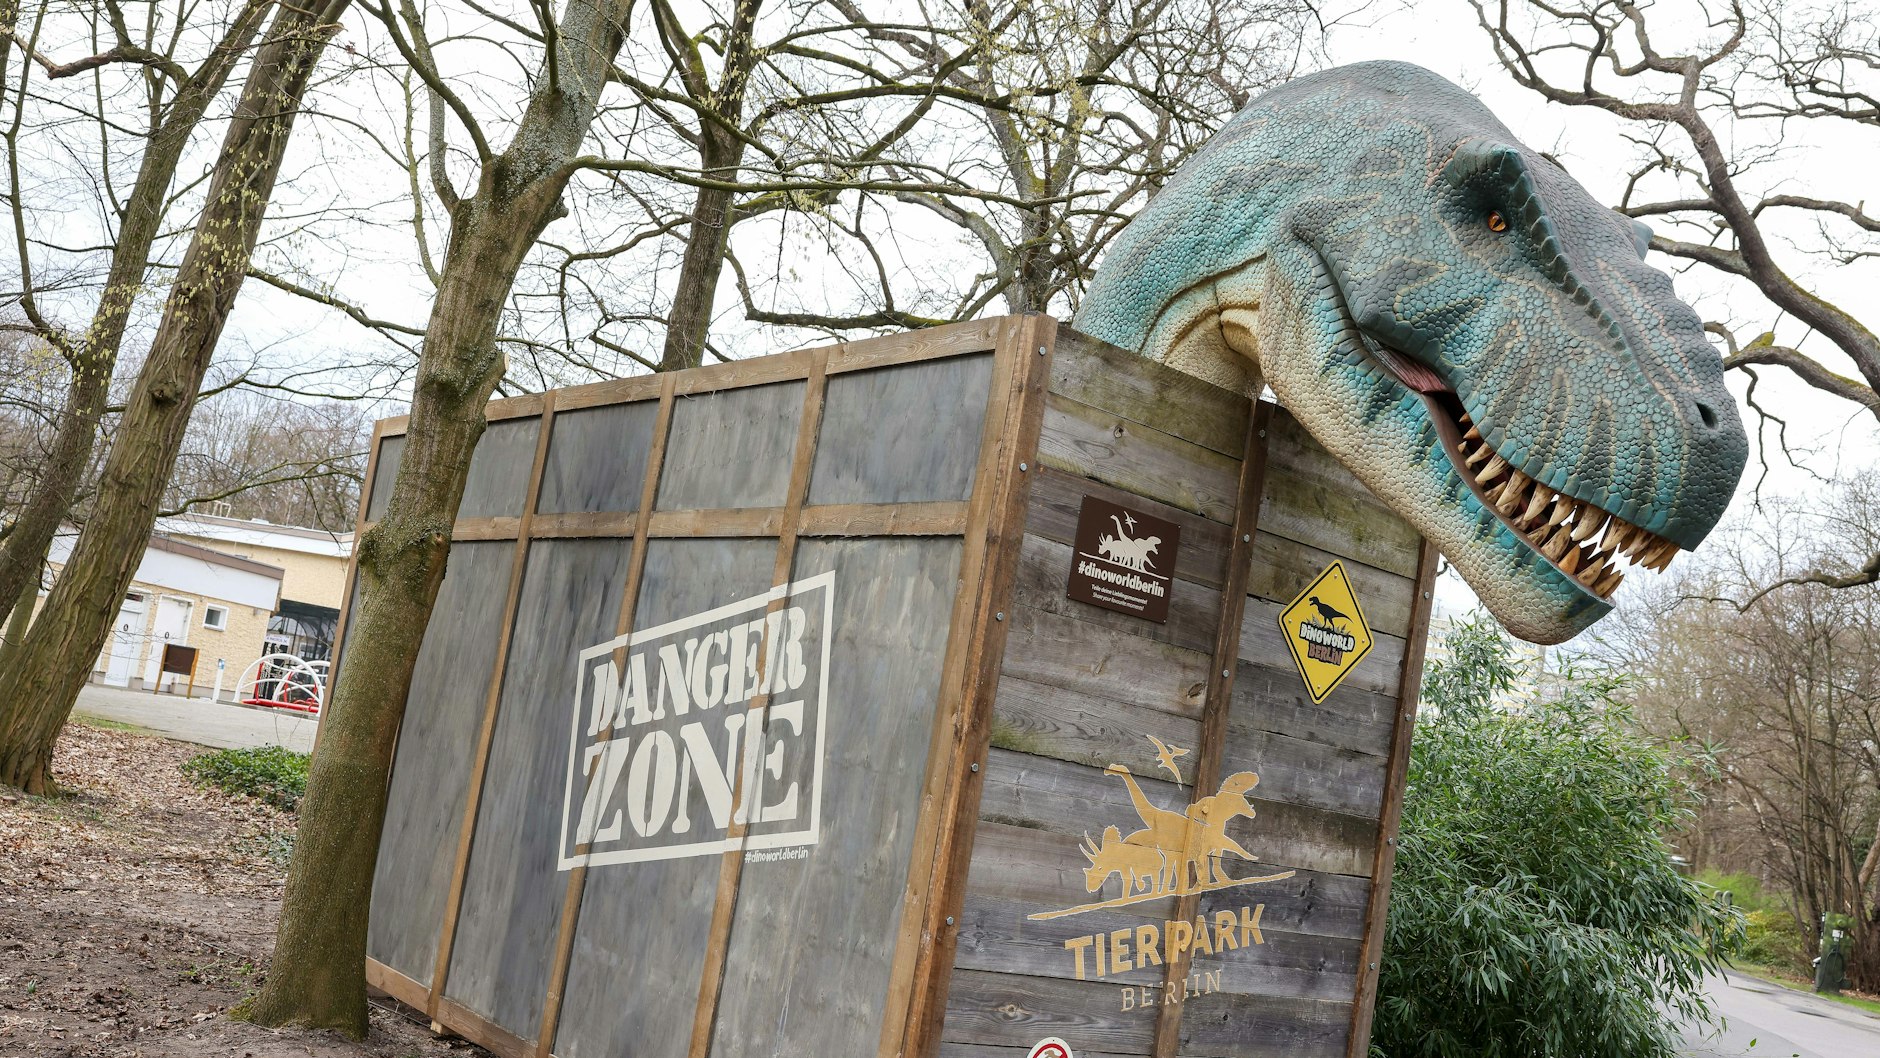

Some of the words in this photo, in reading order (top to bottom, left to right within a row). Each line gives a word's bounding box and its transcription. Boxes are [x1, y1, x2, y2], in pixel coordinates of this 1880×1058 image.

[1078, 561, 1165, 597] #dinoworldberlin
[587, 606, 807, 737] DANGER
[575, 700, 805, 845] ZONE
[744, 846, 808, 863] #dinoworldberlin
[1064, 903, 1265, 980] TIERPARK
[1121, 969, 1222, 1012] BERLIN
